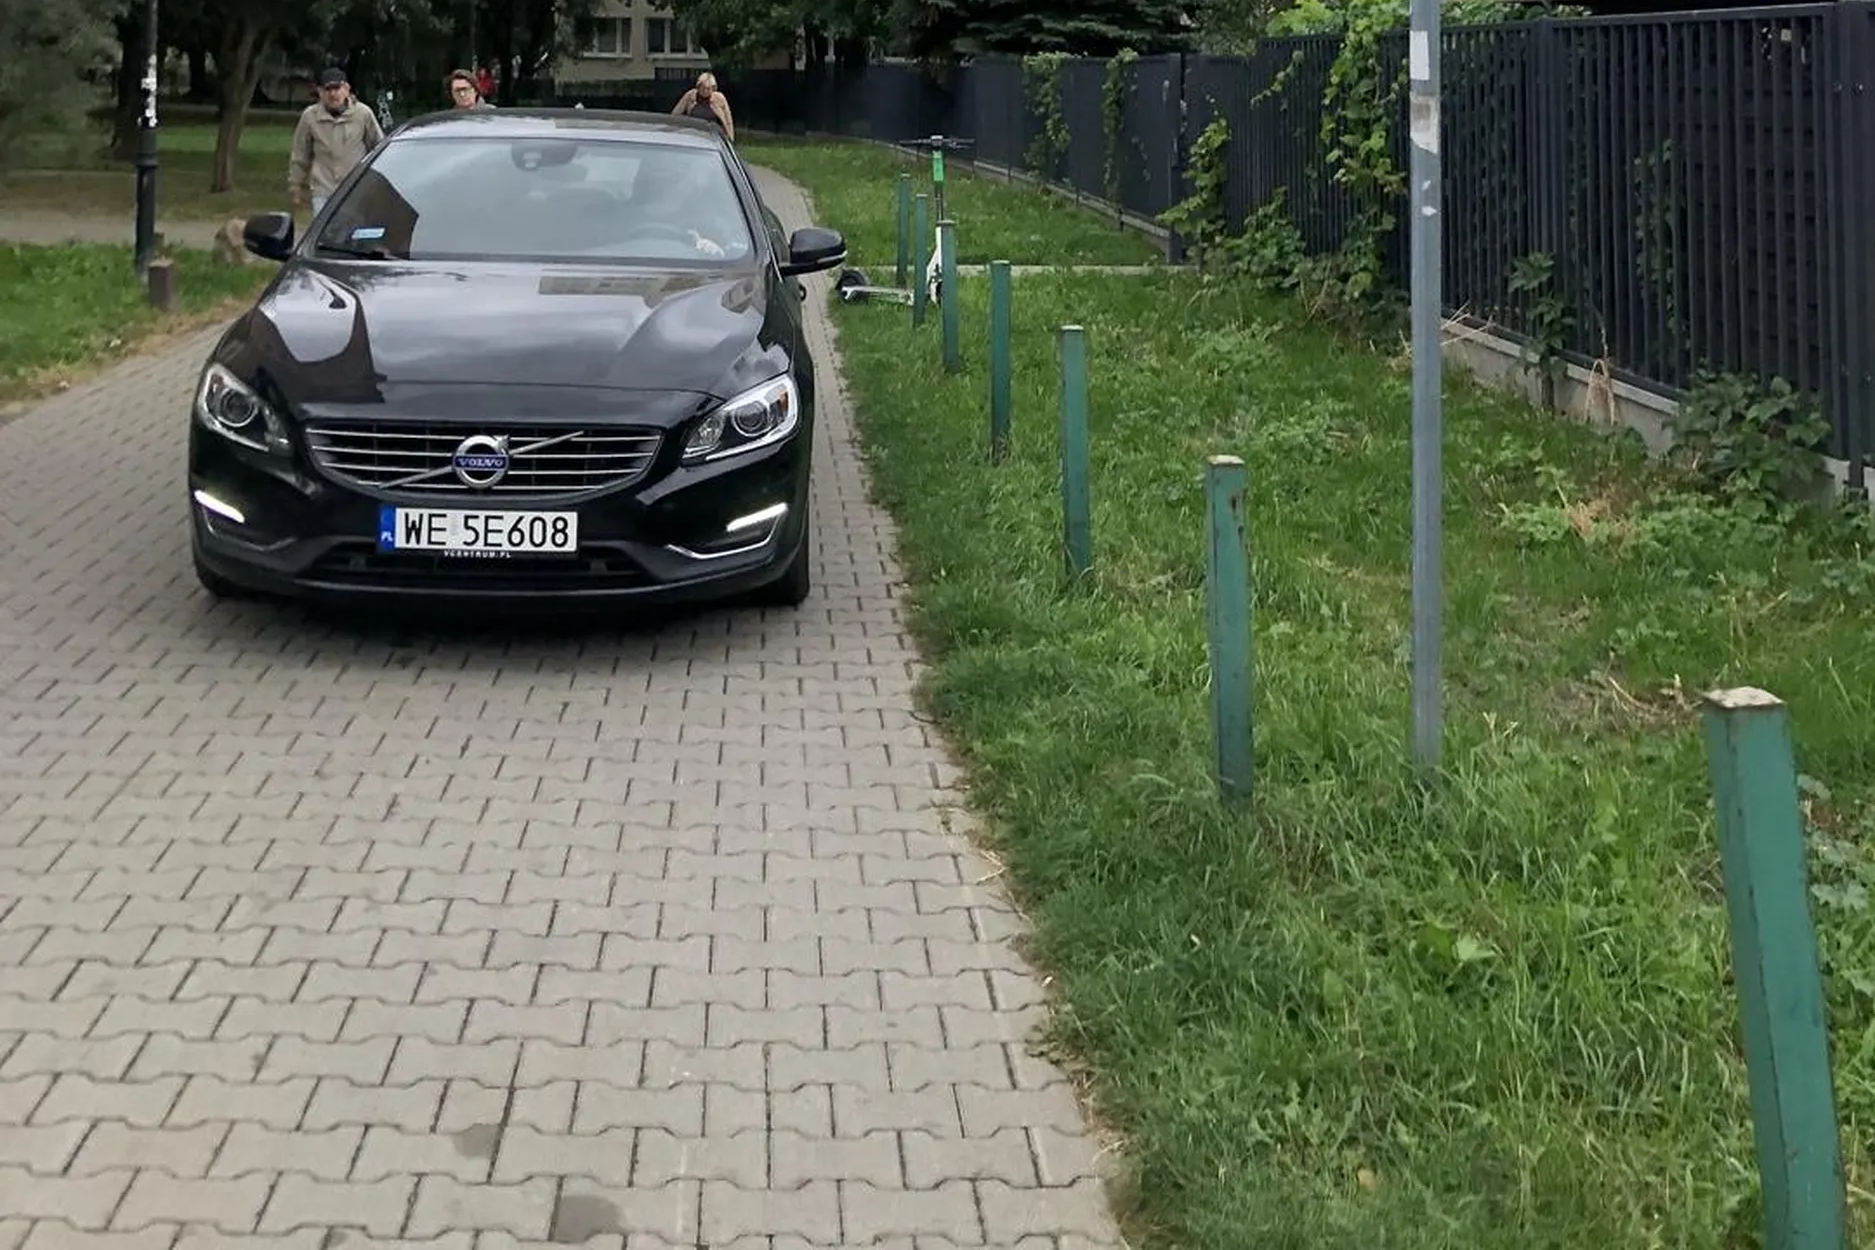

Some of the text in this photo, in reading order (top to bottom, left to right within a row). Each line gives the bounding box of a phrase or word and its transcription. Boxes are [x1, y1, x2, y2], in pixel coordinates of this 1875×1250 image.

[458, 457, 503, 467] VOLVO
[404, 512, 569, 548] WE 5E608
[381, 531, 393, 542] PL
